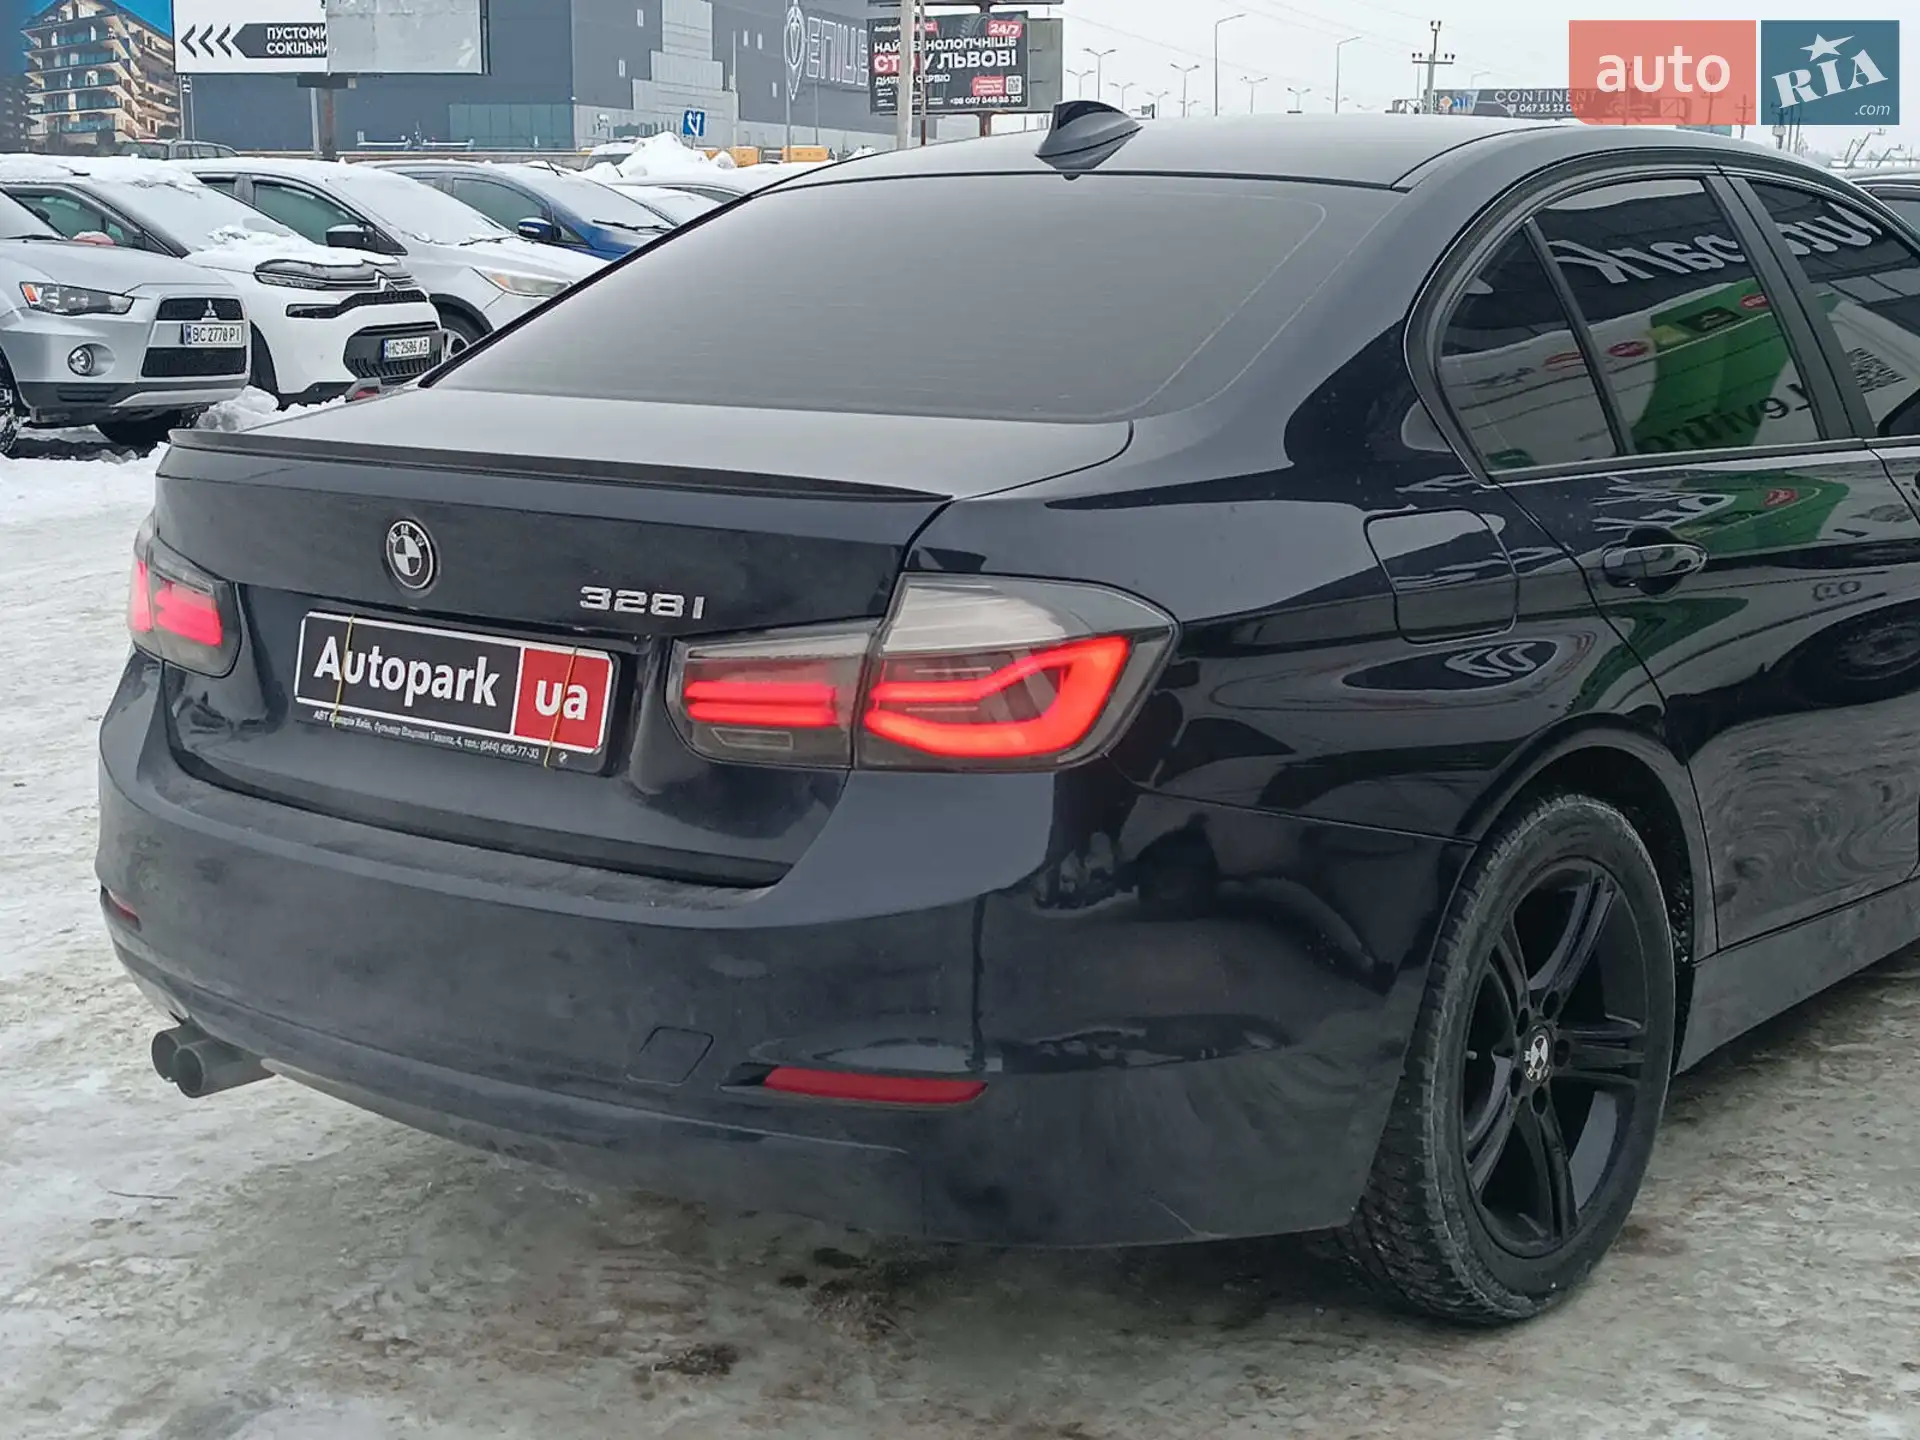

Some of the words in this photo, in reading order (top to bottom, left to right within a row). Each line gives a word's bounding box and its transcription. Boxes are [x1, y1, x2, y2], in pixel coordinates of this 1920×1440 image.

[990, 23, 1019, 35] 24/7
[937, 49, 1017, 70] ЛЬВОВІ
[313, 636, 500, 707] Autopark
[535, 678, 588, 721] ua
